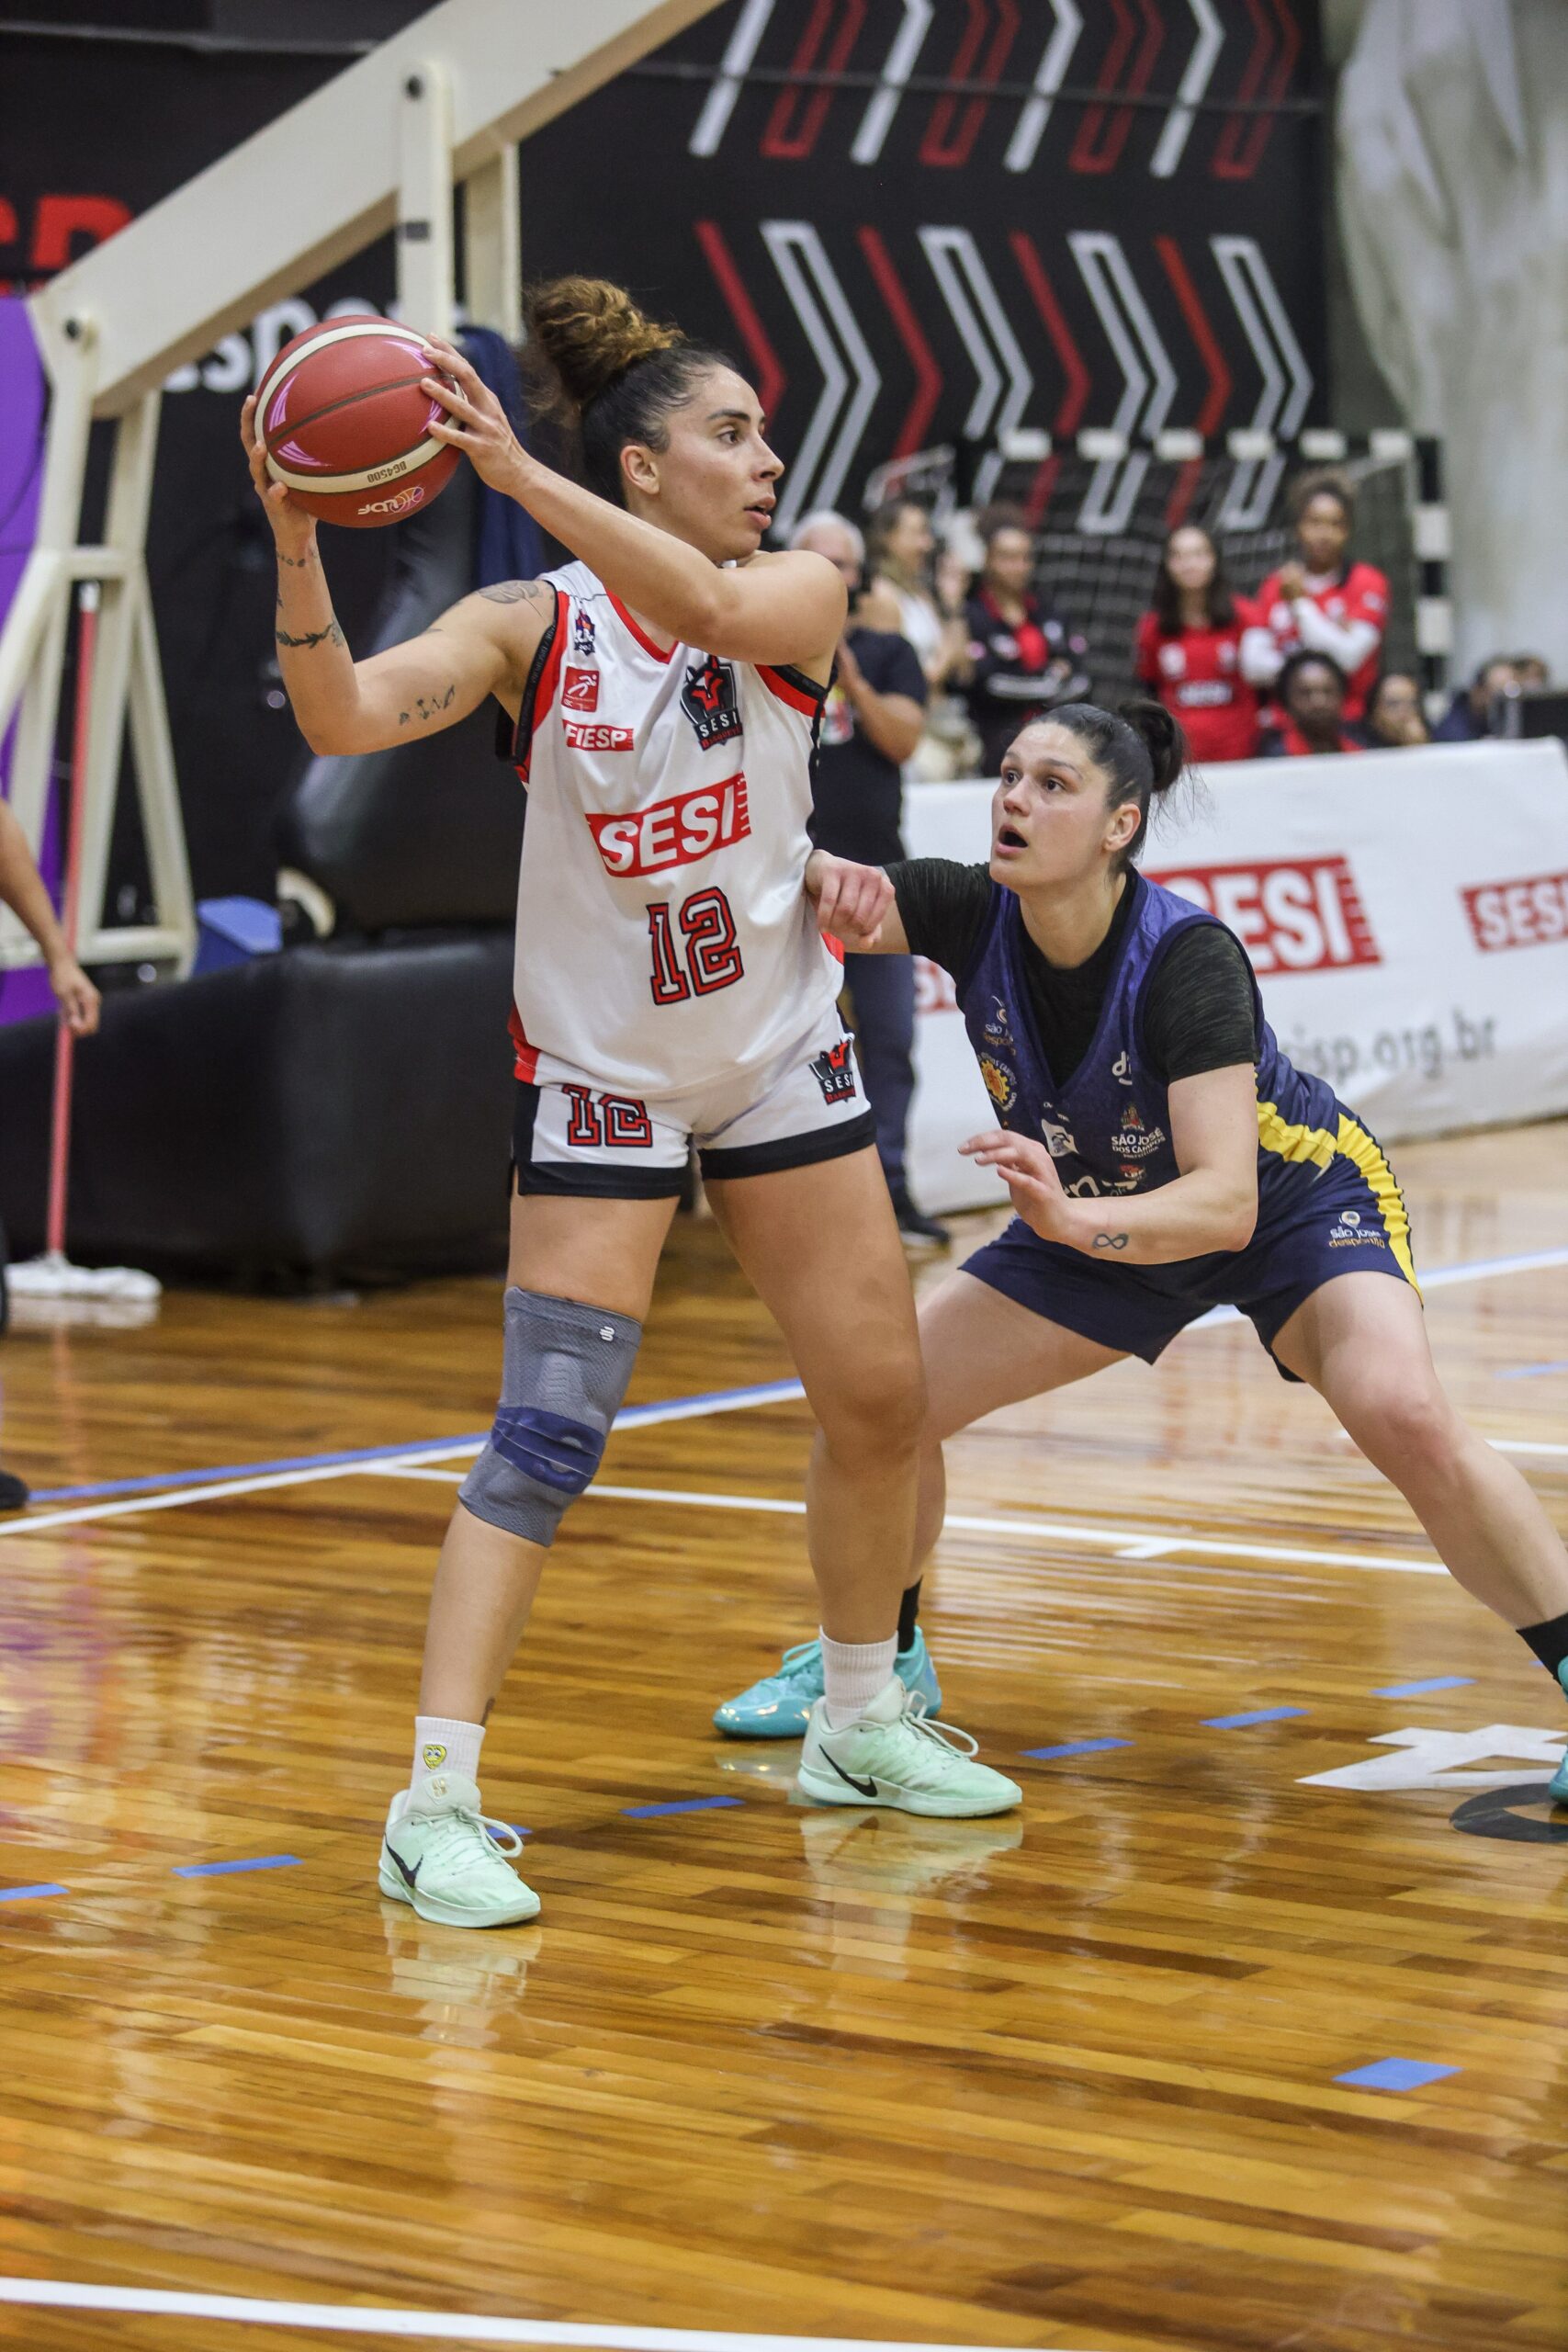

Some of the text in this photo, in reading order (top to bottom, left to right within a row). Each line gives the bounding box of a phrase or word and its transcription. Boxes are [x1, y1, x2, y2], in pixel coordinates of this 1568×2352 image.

[566, 724, 627, 749] FIESP
[699, 711, 738, 738] SESI
[599, 786, 735, 872] SESI
[646, 886, 744, 1005] 12
[824, 1074, 854, 1093] SESI
[561, 1083, 653, 1148] 12
[1111, 1133, 1136, 1147] SÃO
[1111, 1145, 1131, 1154] DOS
